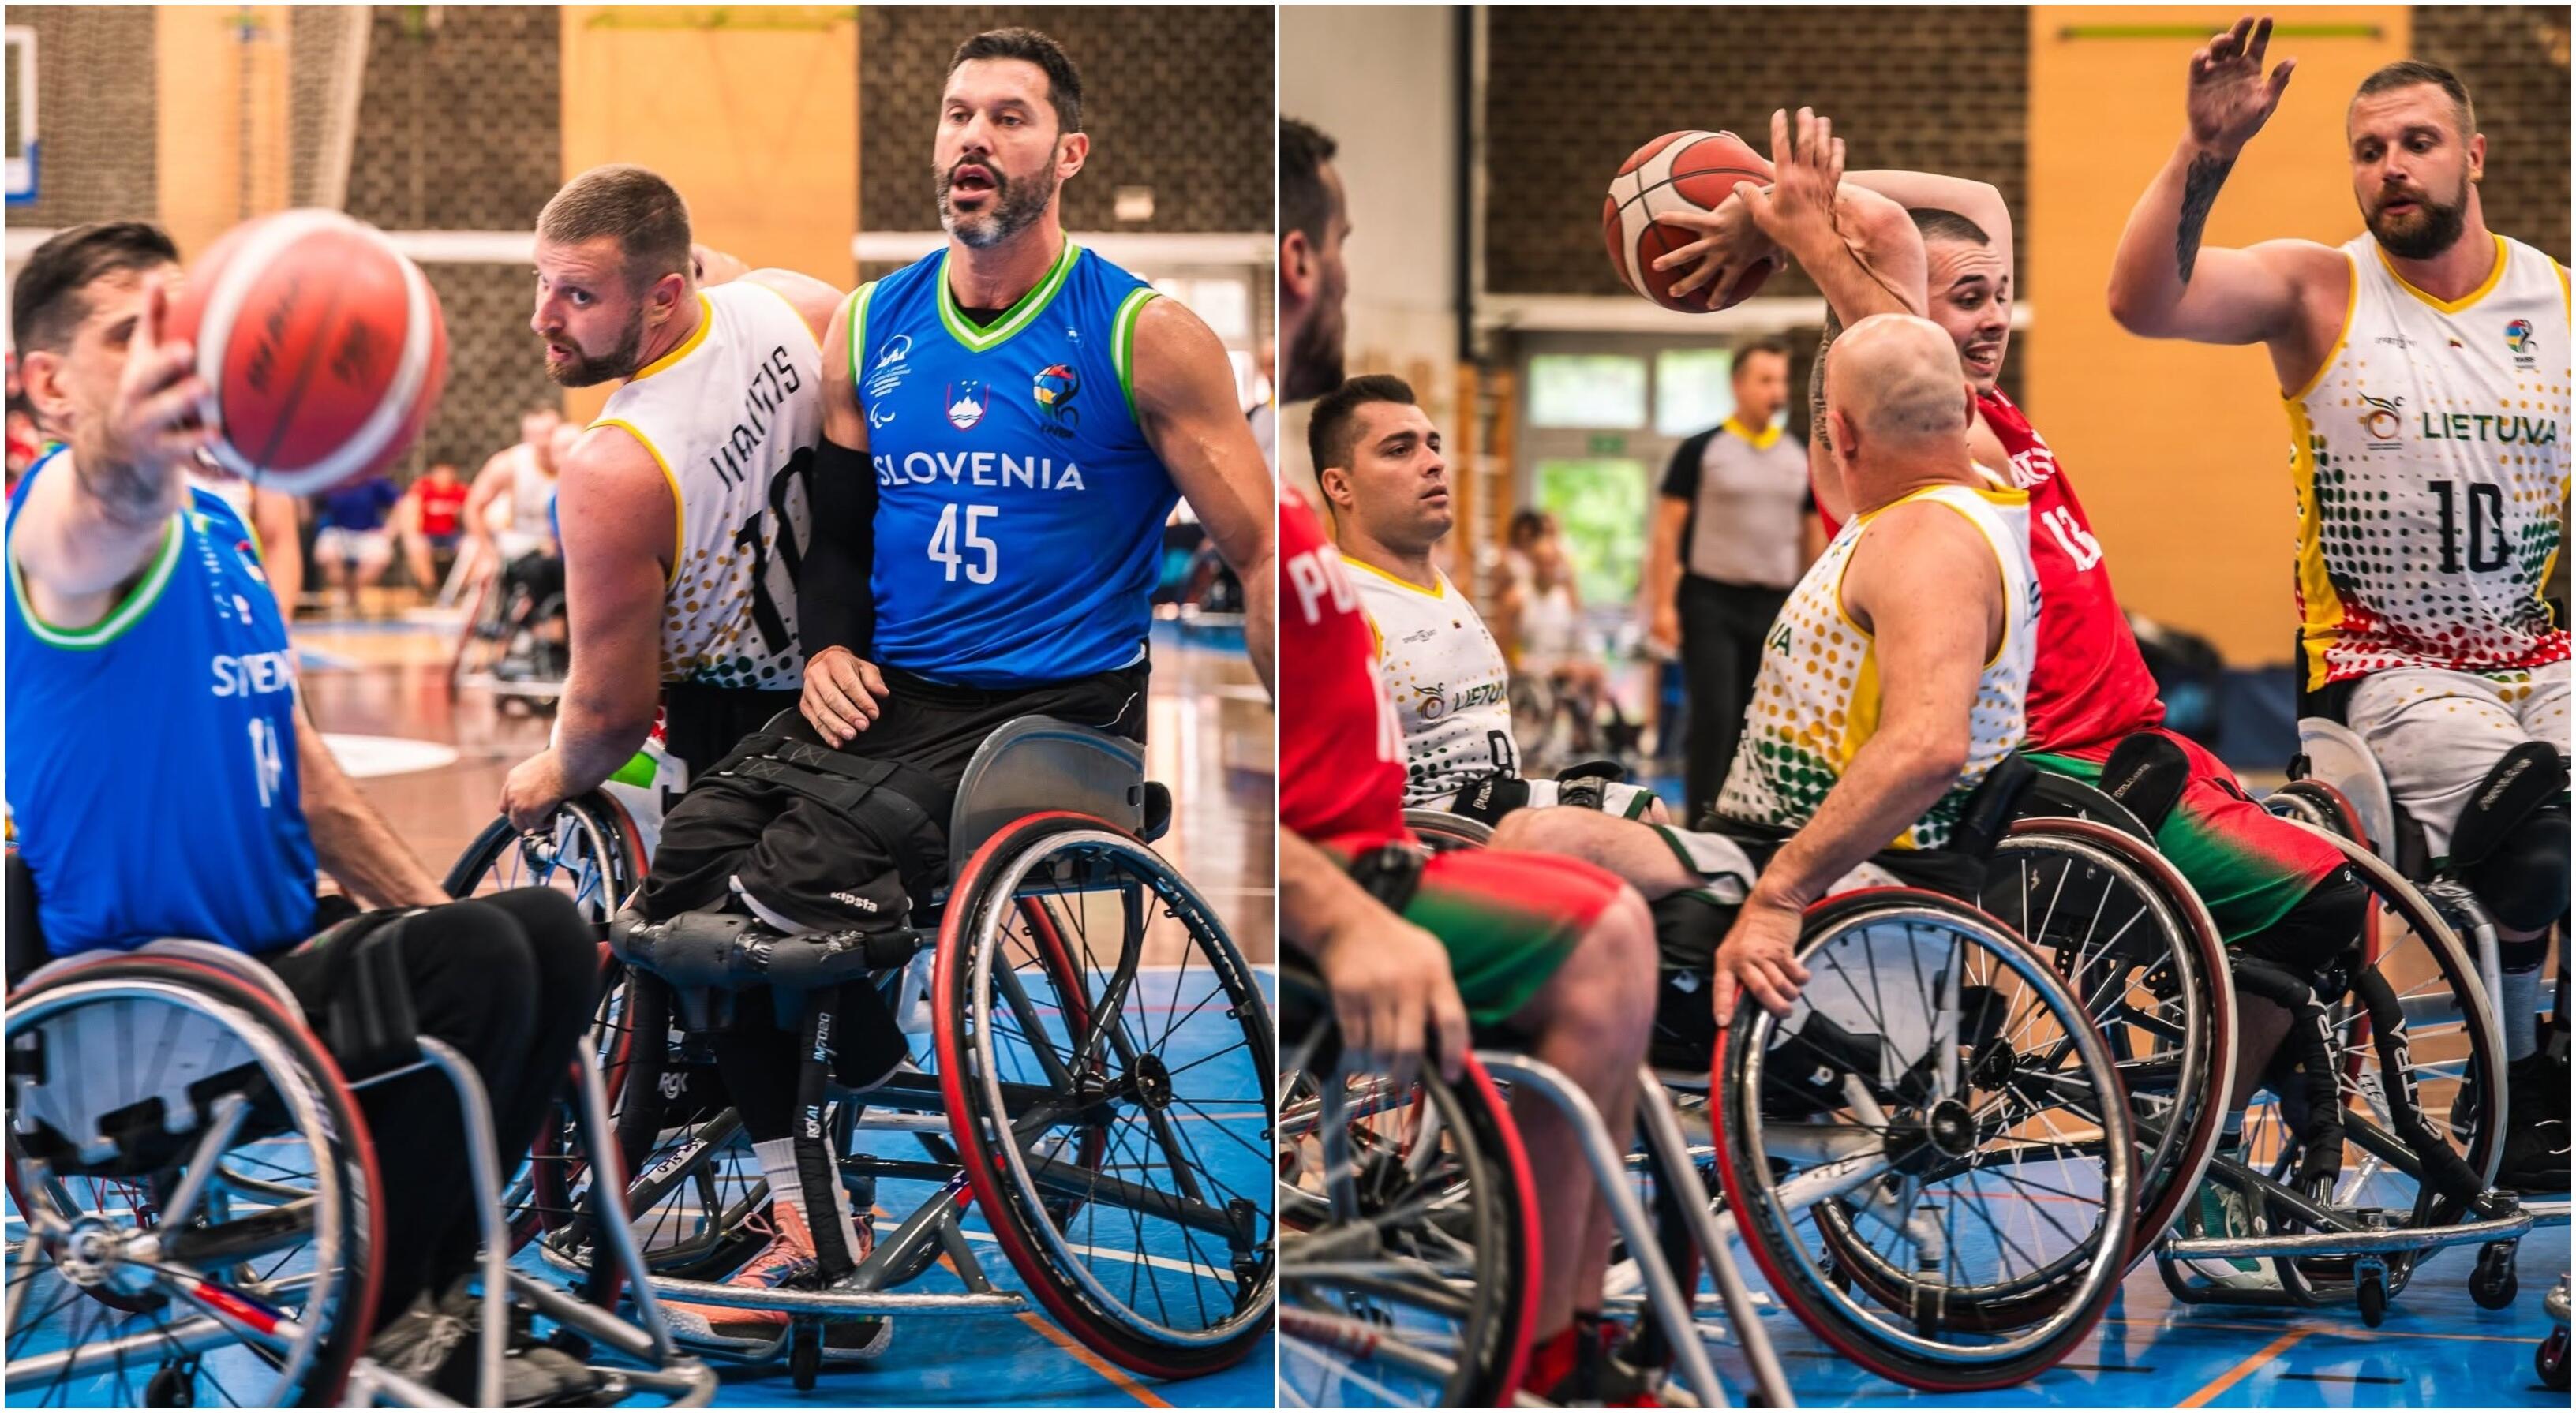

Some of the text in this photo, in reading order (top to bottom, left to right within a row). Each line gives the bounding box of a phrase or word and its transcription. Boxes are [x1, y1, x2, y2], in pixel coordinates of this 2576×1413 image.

[2422, 411, 2558, 445] LIETUVA
[873, 451, 1086, 491] SLOVENIA
[927, 503, 999, 585] 45
[2041, 505, 2103, 572] 13
[2428, 480, 2511, 574] 10
